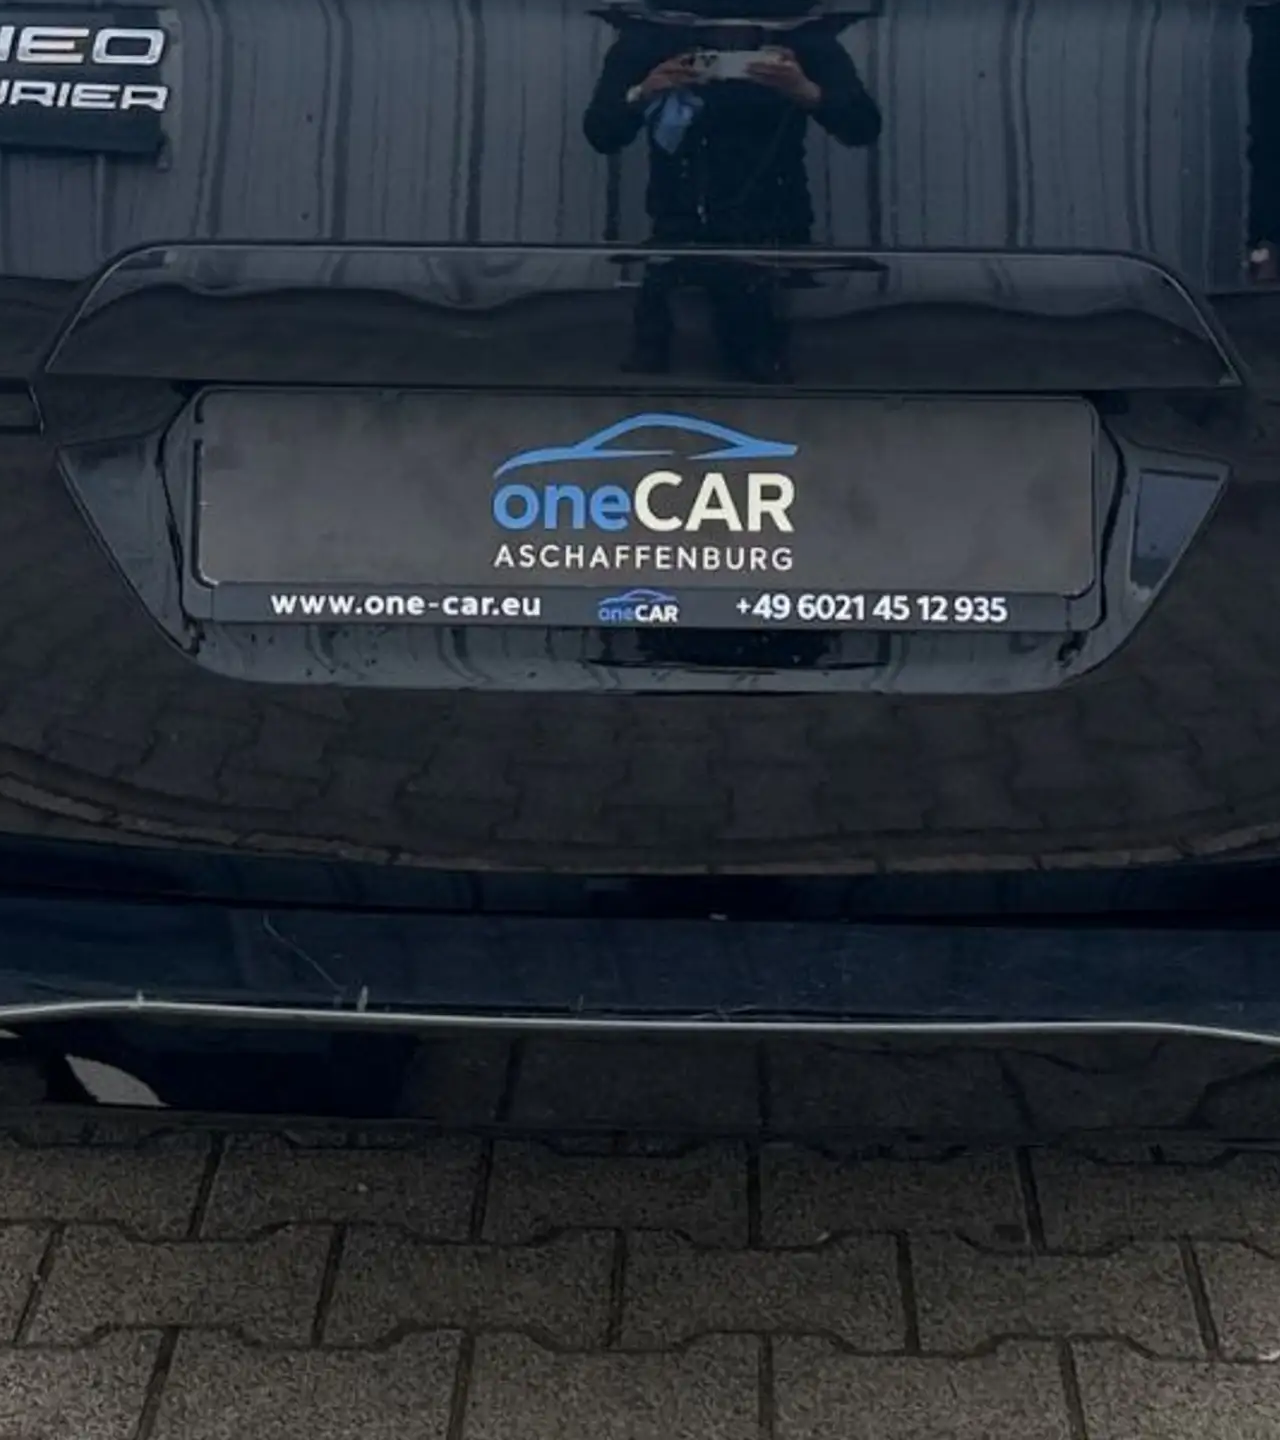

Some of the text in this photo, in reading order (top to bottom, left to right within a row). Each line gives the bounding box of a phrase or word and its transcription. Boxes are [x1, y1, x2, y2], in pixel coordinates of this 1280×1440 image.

[493, 470, 796, 532] oneCAR
[493, 544, 794, 571] ASCHAFFENBURG
[271, 594, 542, 616] www.one-car.eu
[736, 593, 1008, 623] +49 6021 45 12 935
